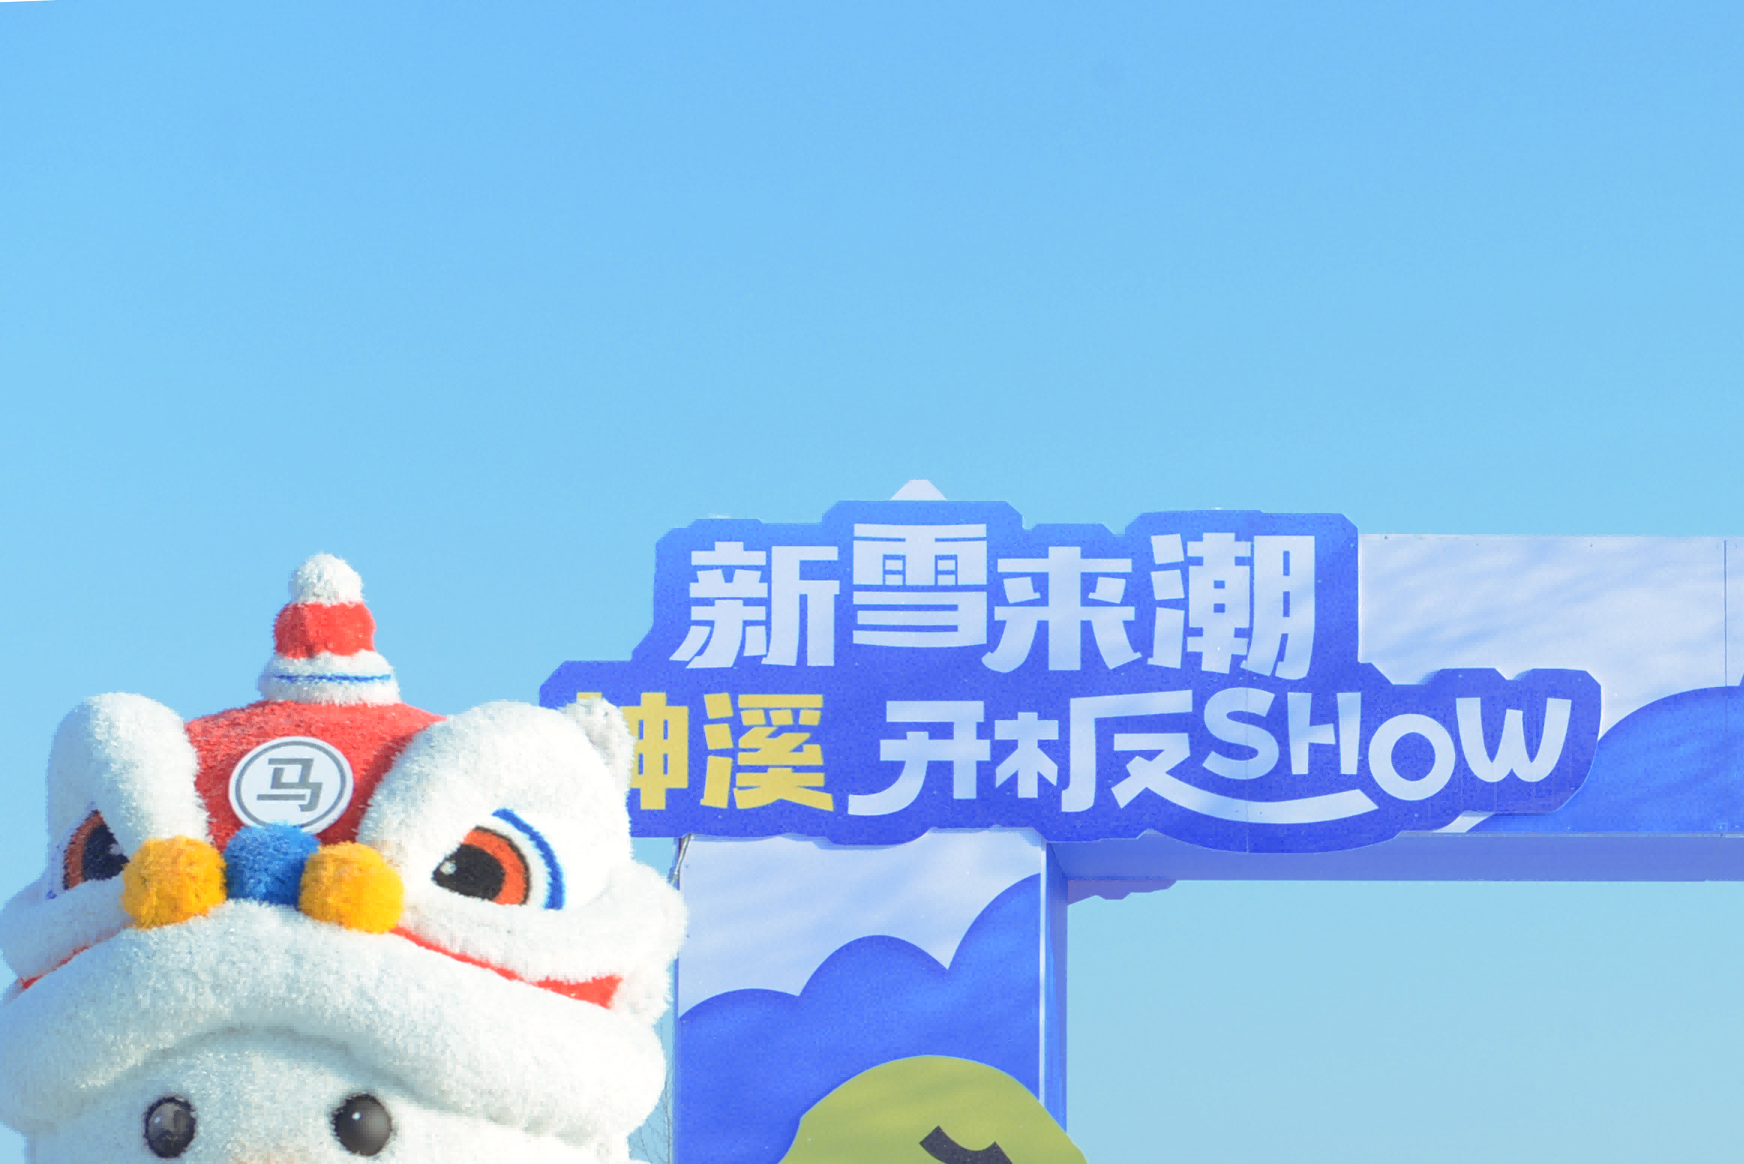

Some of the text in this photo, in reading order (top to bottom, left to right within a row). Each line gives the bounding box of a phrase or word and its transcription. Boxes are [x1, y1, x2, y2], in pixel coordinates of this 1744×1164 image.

[671, 523, 1315, 679] 新雪来潮
[256, 758, 323, 812] 马
